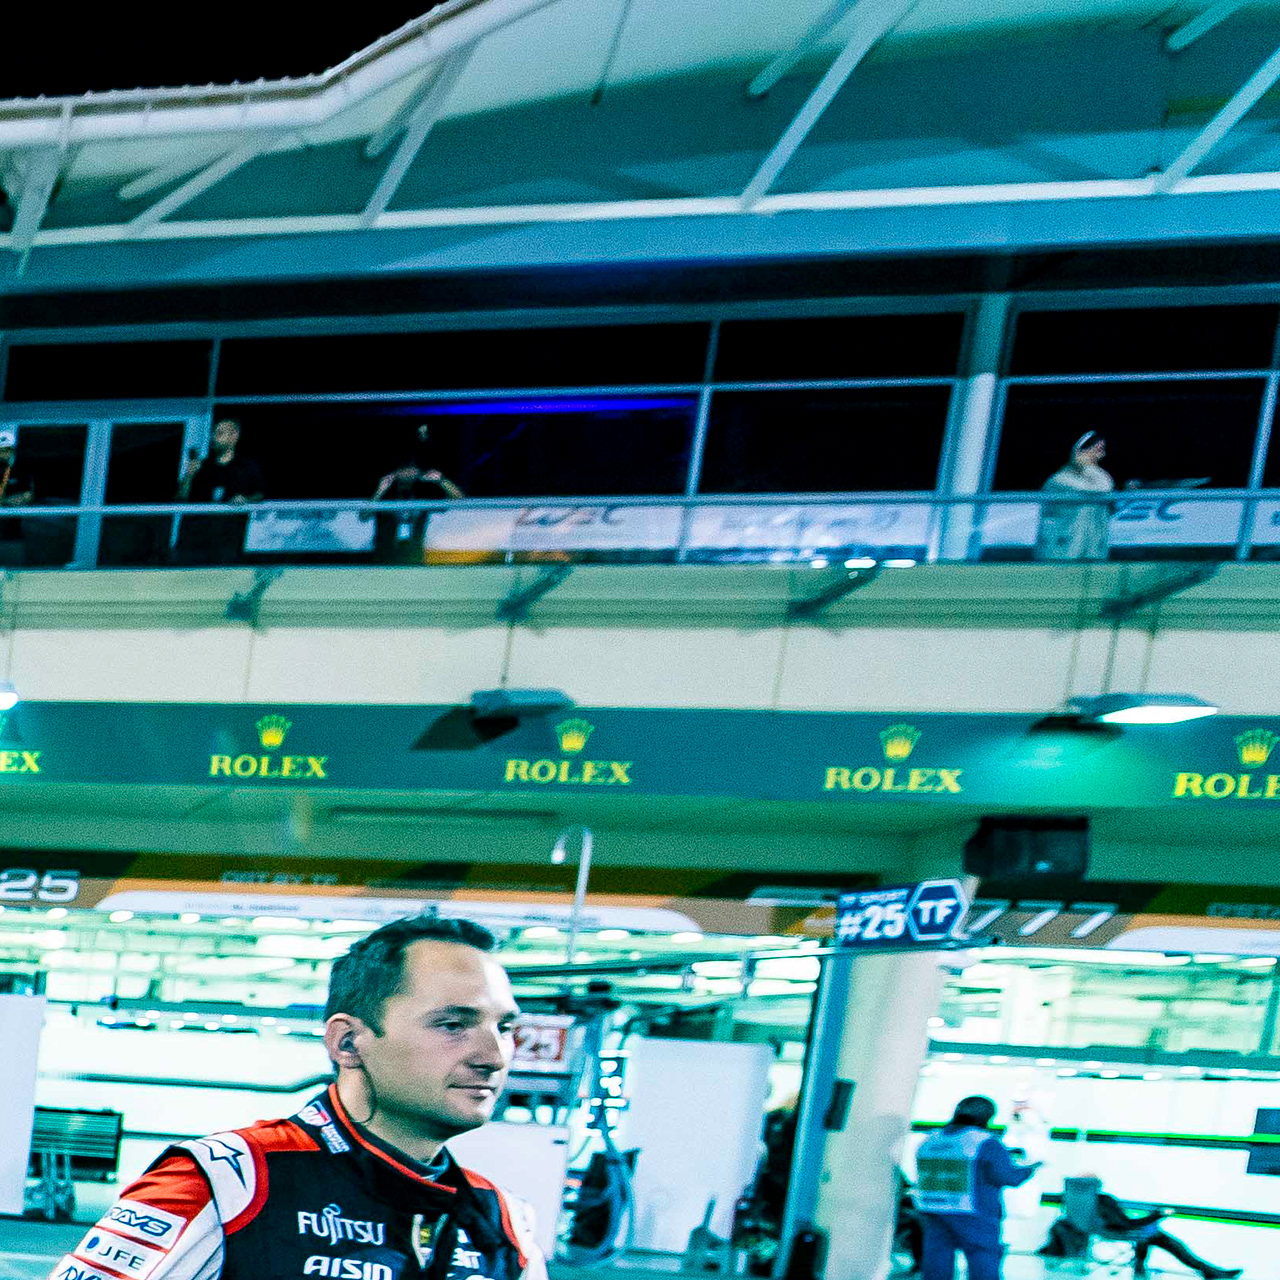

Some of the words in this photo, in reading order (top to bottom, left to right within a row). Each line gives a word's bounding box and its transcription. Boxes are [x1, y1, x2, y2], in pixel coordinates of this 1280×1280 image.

[209, 754, 328, 779] ROLEX
[503, 758, 632, 785] ROLEX
[824, 766, 963, 794] ROLEX
[1173, 772, 1280, 800] ROLE
[839, 903, 907, 941] #25
[918, 898, 958, 925] TF
[516, 1026, 560, 1060] 25
[297, 1204, 385, 1246] FUJITSU
[97, 1246, 145, 1271] JFE
